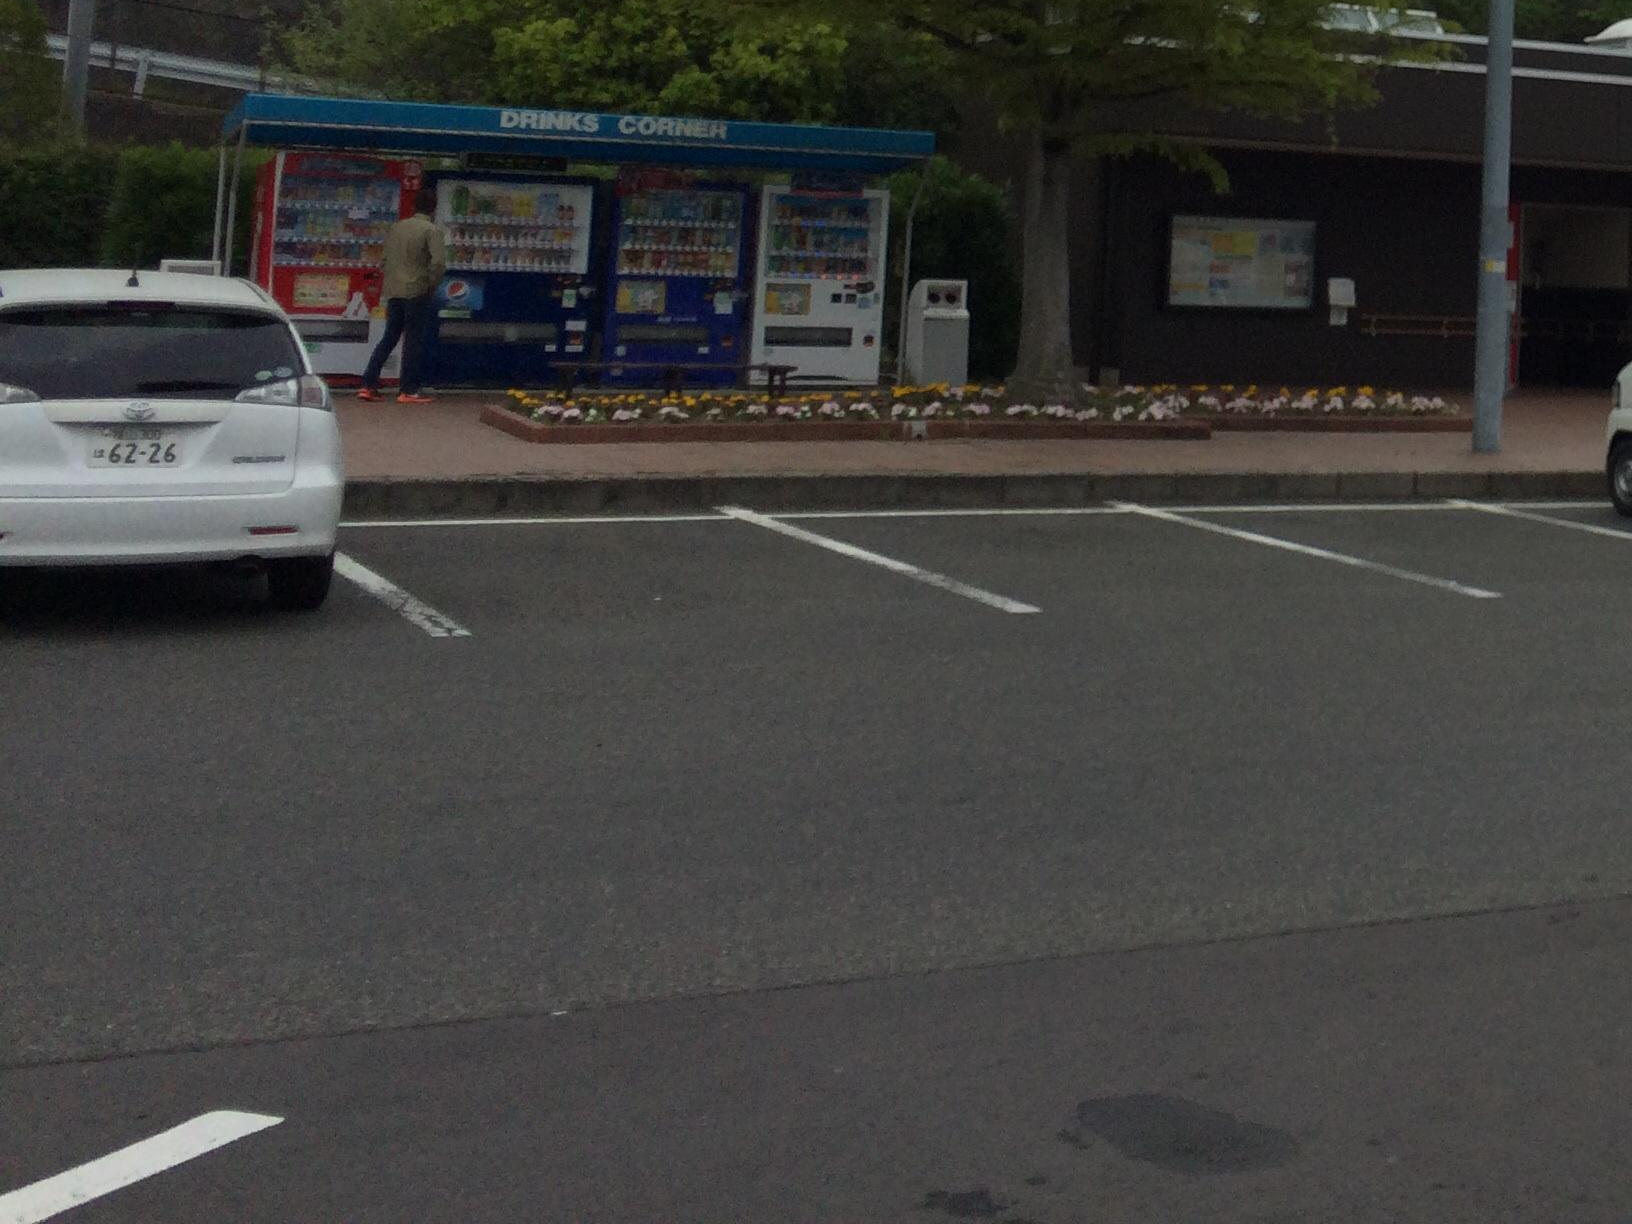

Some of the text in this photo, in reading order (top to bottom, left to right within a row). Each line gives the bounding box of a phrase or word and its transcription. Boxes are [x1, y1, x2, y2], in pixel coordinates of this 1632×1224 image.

[500, 110, 728, 139] DRINKS CORNER
[109, 442, 176, 464] 62-26
